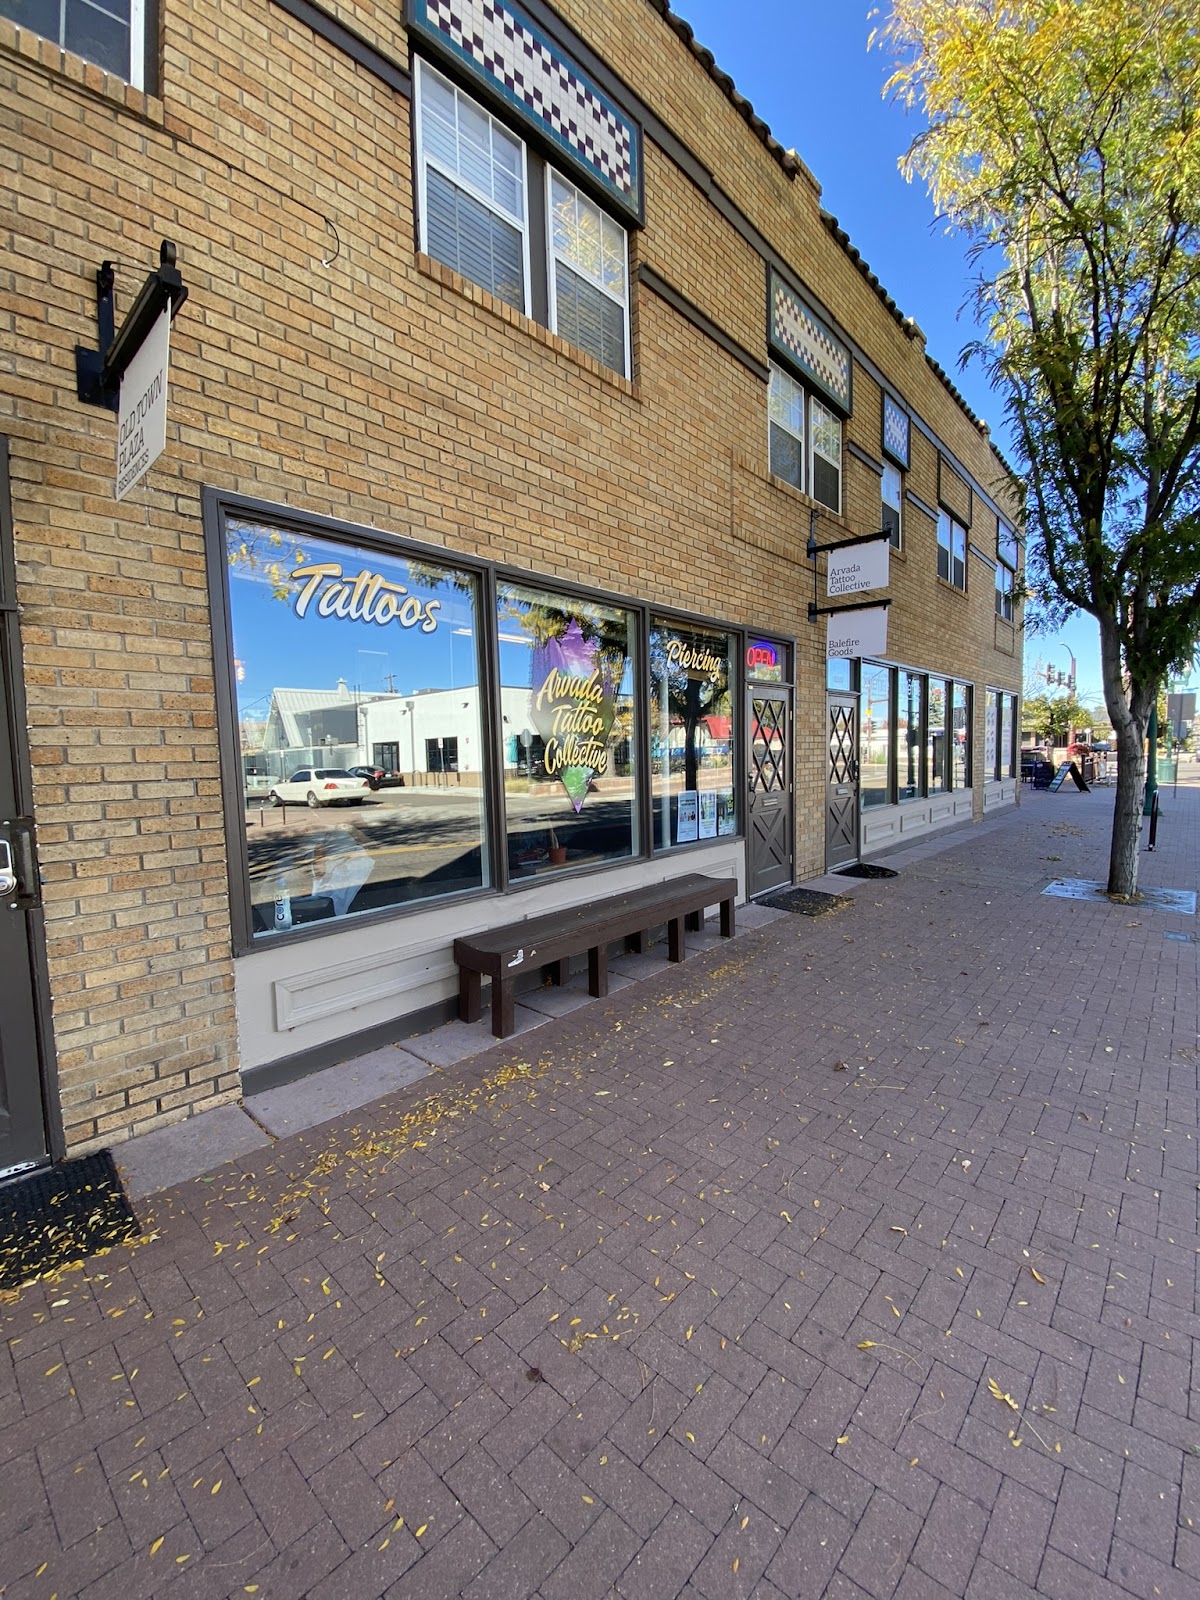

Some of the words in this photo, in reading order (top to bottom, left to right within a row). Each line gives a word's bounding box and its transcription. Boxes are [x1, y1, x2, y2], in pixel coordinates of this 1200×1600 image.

[120, 410, 135, 446] OLD
[137, 368, 163, 425] TOWN
[118, 448, 149, 492] RESIDENCES
[119, 426, 145, 475] PLAZA
[829, 564, 861, 576] Arvada
[829, 575, 856, 585] Tattoo
[829, 580, 871, 593] Collective
[290, 562, 442, 635] Tattoos
[666, 640, 722, 683] Piercing
[747, 646, 775, 669] OPEN
[828, 638, 860, 648] Balefire
[828, 647, 854, 657] Goods
[536, 667, 604, 712] Arvada
[551, 700, 605, 736] Tattoo
[544, 733, 608, 775] Collective
